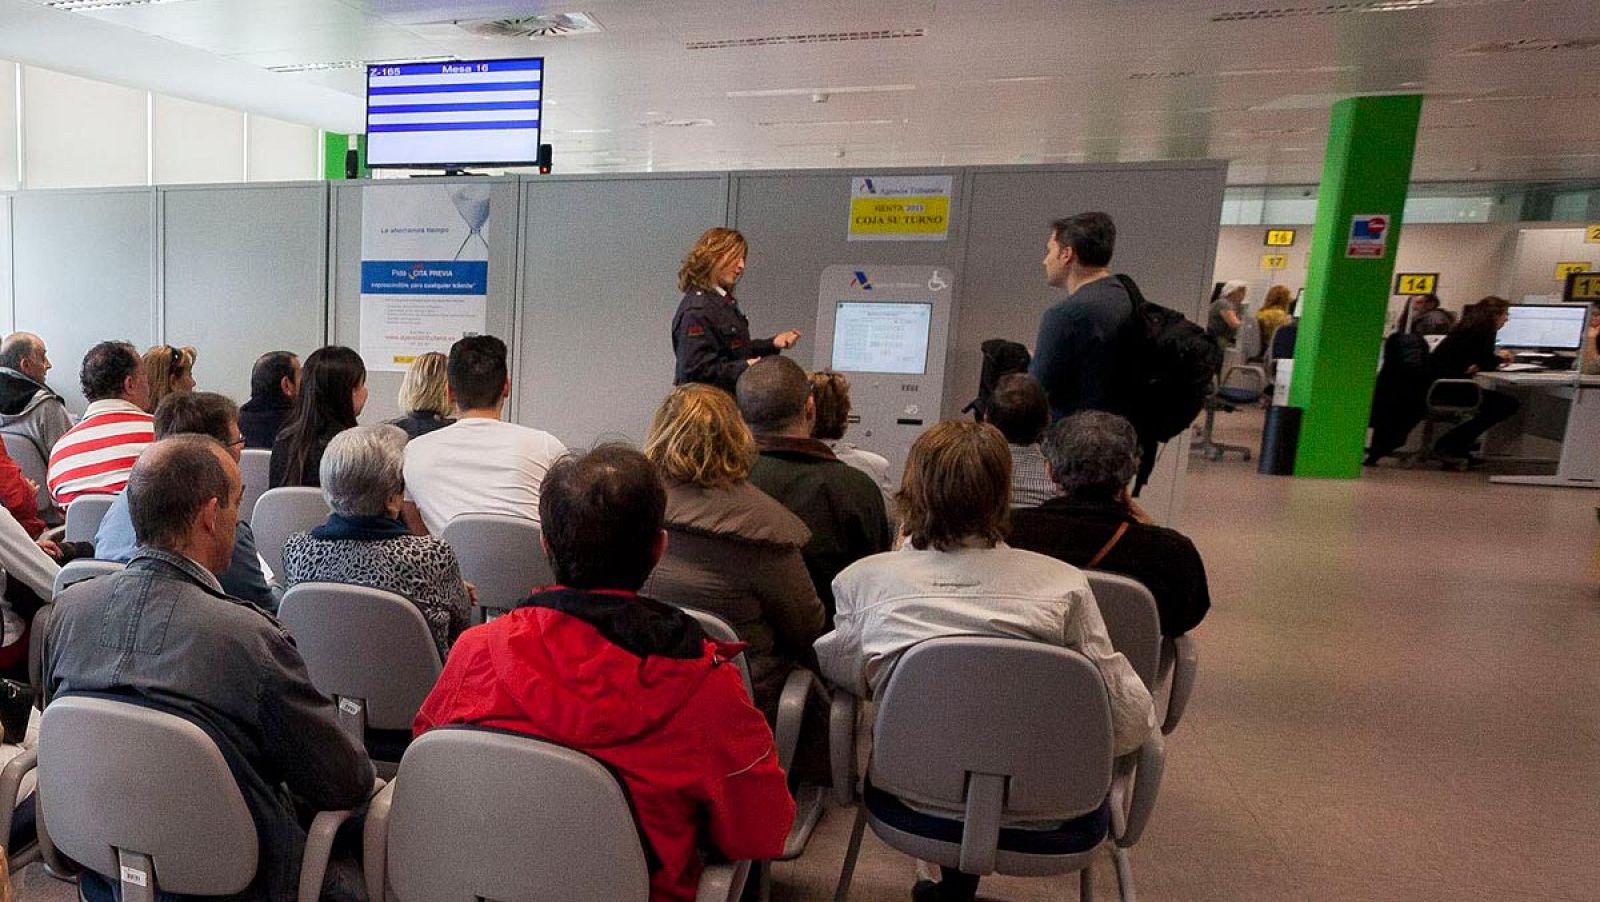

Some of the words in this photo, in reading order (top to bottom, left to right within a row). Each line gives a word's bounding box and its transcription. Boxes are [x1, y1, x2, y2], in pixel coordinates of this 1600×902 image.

[370, 67, 400, 76] Z-165
[442, 64, 472, 73] Mesa
[476, 63, 489, 72] 16
[875, 204, 903, 213] RENTA
[855, 216, 885, 225] COJA
[887, 215, 900, 225] SU
[903, 215, 943, 225] TURNO
[1274, 233, 1287, 243] 16
[1270, 256, 1282, 266] 17
[391, 269, 408, 277] Pida
[413, 269, 429, 277] CITA
[429, 269, 453, 277] PREVIA
[1407, 278, 1427, 291] 14
